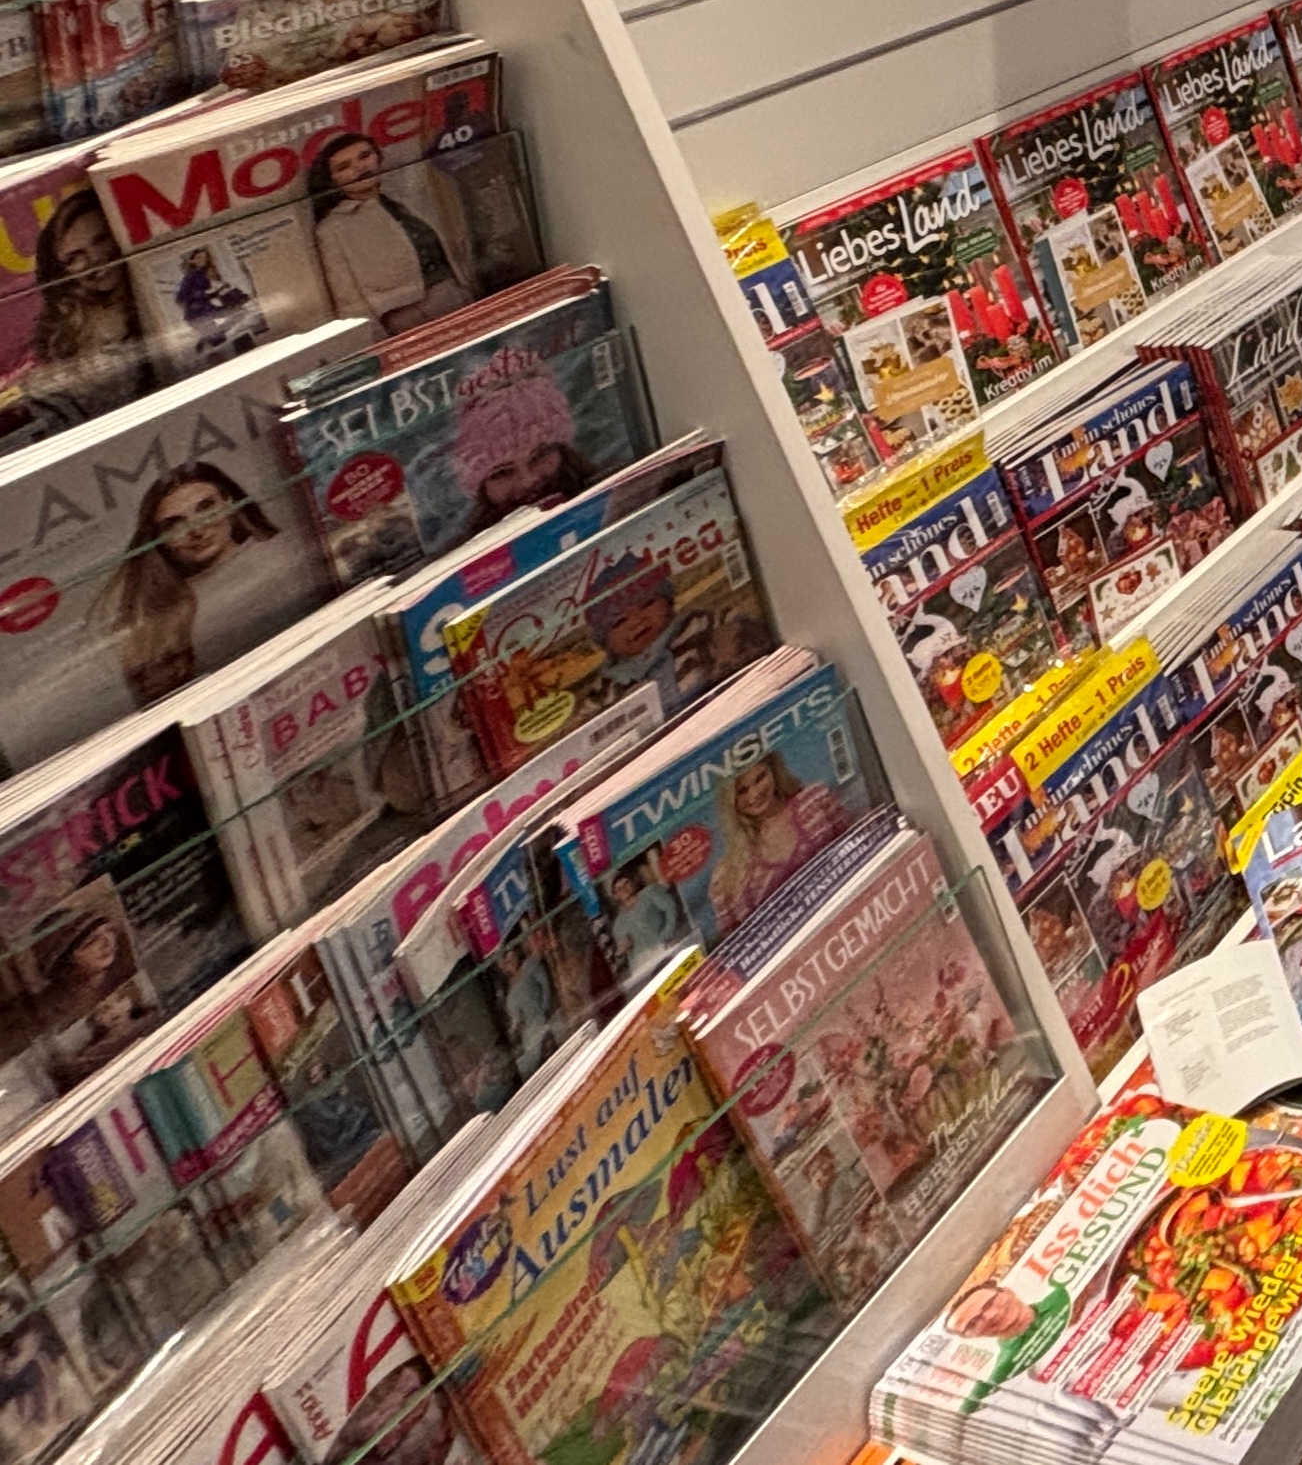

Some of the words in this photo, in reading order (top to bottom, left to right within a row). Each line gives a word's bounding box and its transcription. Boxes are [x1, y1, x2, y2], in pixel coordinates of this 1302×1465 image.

[438, 124, 473, 149] 40
[932, 445, 976, 484] Preis
[1037, 379, 1182, 504] Land
[1100, 392, 1159, 438] schönes
[610, 681, 835, 845] TWINSETS
[1024, 751, 1039, 772] 2
[1038, 717, 1084, 759] Hefte
[1107, 655, 1148, 695] Preis
[1000, 695, 1164, 888] Land
[733, 850, 932, 1054] SELBSTGEMACHT
[521, 1123, 587, 1218] Lust
[594, 1048, 641, 1129] auf
[1021, 1215, 1082, 1284] Iss
[1079, 1138, 1149, 1218] dich
[1046, 1144, 1167, 1288] GESUND
[1164, 1346, 1235, 1430] Seele
[1227, 1247, 1298, 1344] wieder
